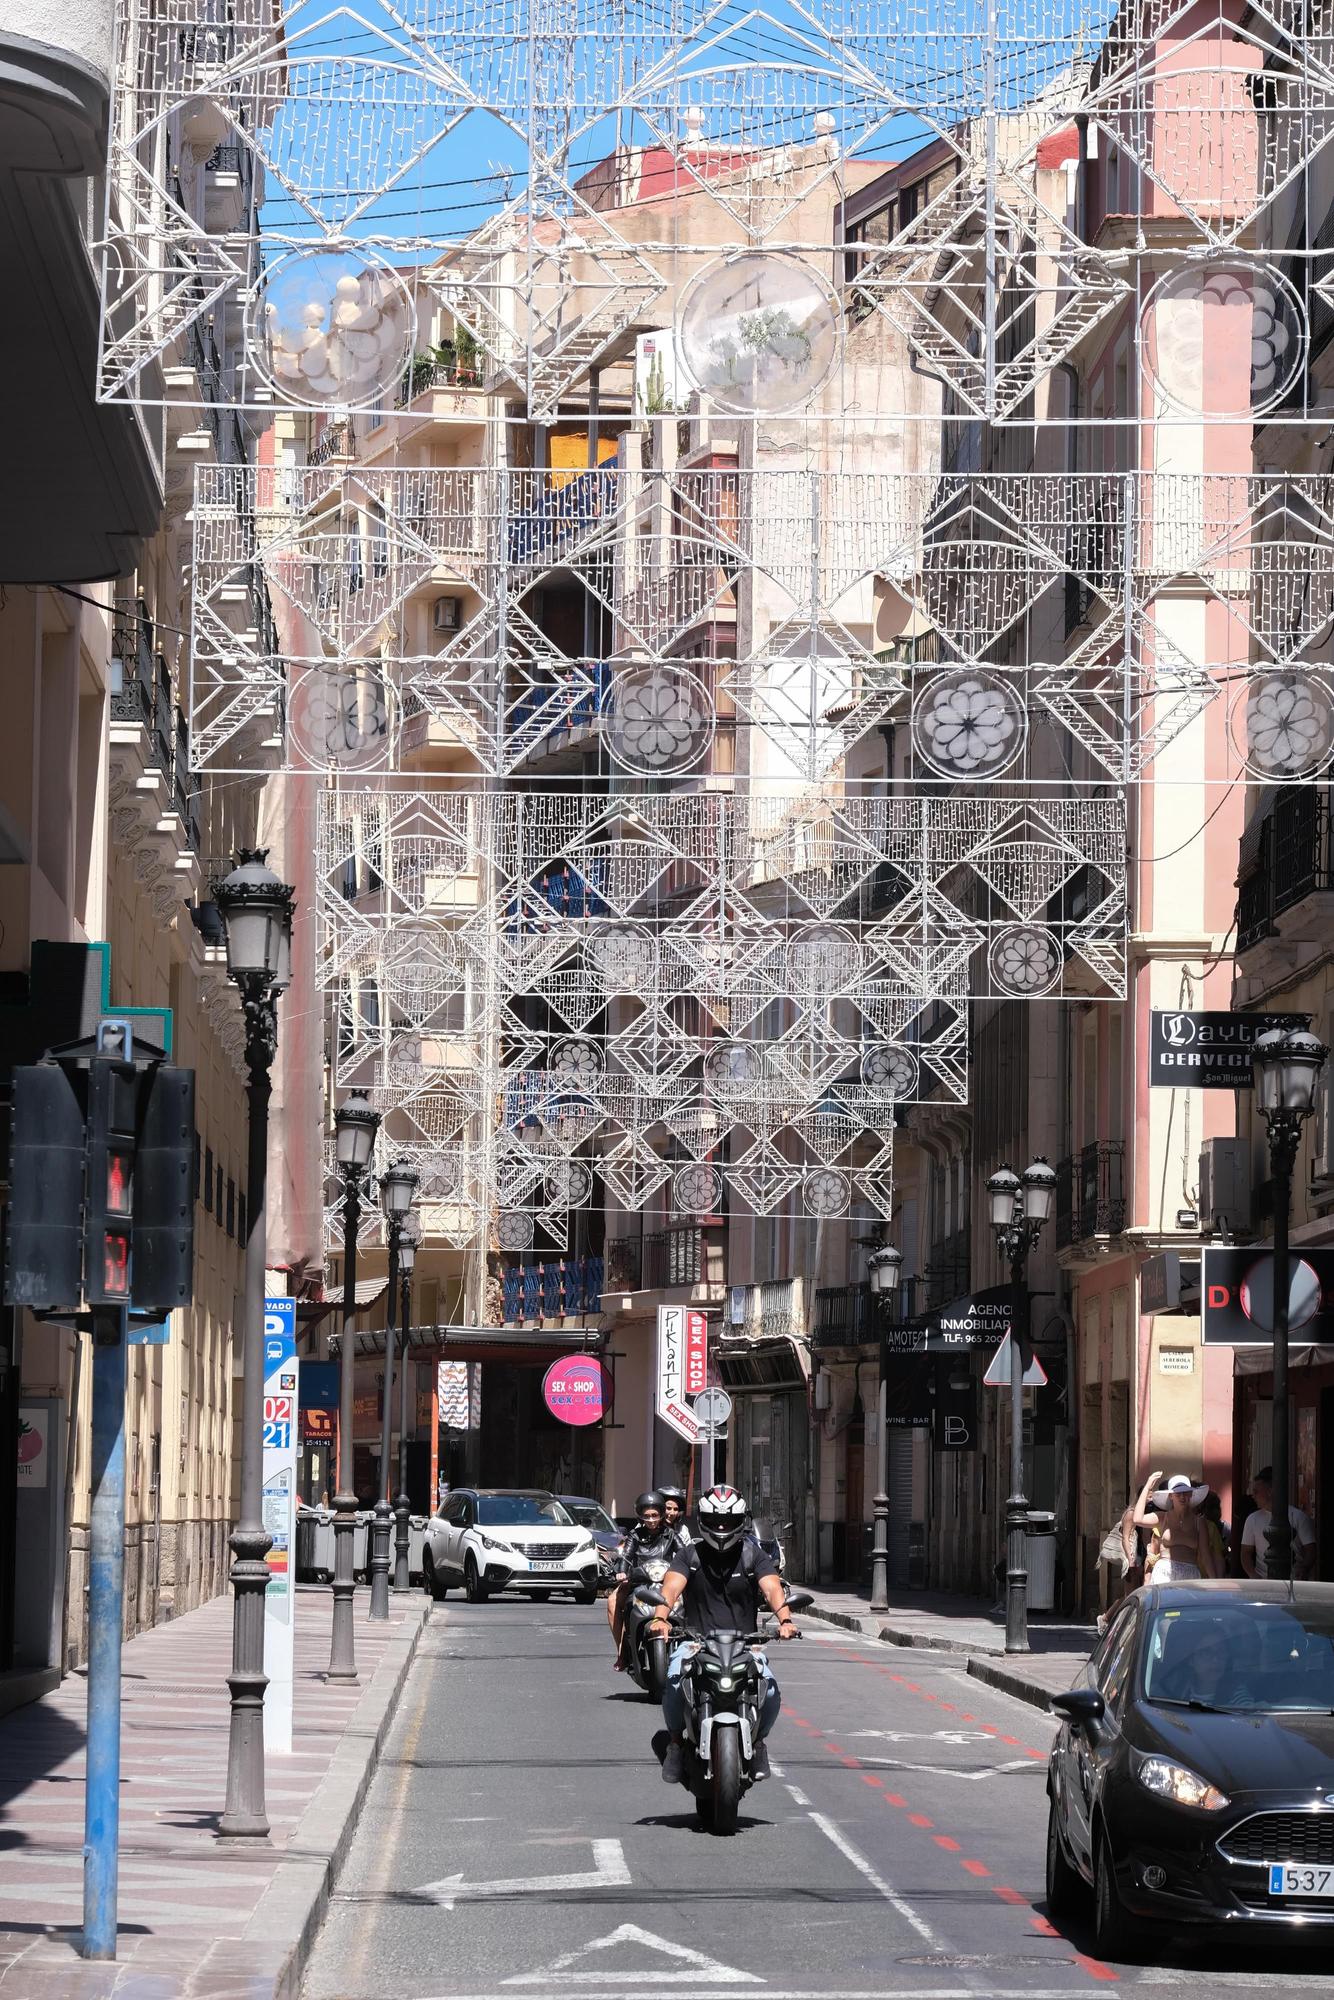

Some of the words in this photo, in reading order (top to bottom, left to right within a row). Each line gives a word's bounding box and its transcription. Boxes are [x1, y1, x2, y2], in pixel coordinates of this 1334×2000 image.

[1202, 1073, 1221, 1084] San
[1223, 1073, 1251, 1084] Miguel
[264, 1315, 285, 1335] P
[691, 1316, 703, 1345] SEX
[943, 1333, 963, 1343] TLF:
[965, 1334, 982, 1344] 965
[690, 1351, 703, 1389] SHOP
[552, 1381, 566, 1392] SEX
[573, 1381, 595, 1392] SHOP
[263, 1397, 290, 1421] 02
[551, 1395, 572, 1404] sex
[669, 1406, 683, 1420] SEX
[263, 1423, 287, 1448] 21
[1287, 1870, 1331, 1892] 537
